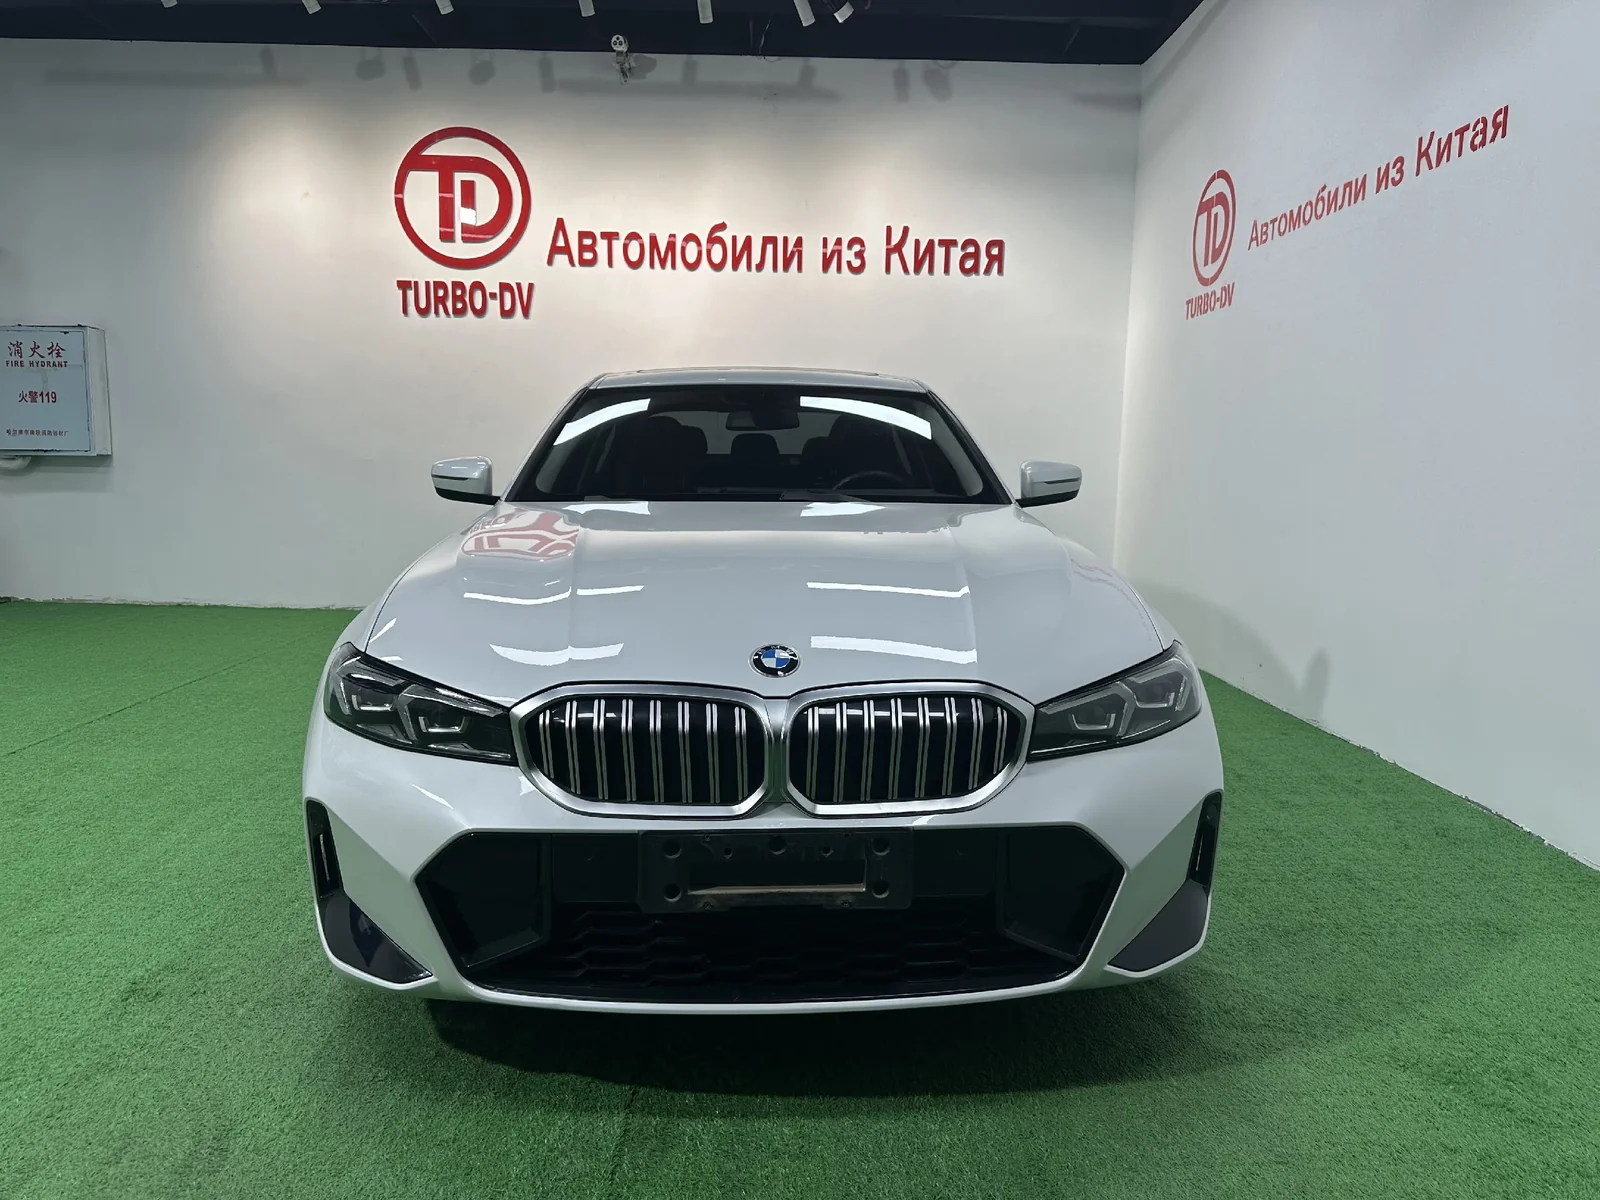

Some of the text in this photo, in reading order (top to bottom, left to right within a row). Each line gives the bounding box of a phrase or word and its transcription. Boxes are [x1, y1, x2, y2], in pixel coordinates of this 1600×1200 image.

[1247, 105, 1510, 251] Автомобили из Китая
[545, 216, 1006, 277] Автомобили из Китая
[396, 279, 536, 320] TURBO-DV
[1185, 282, 1236, 321] TURBO-DV
[8, 341, 66, 358] 消火栓
